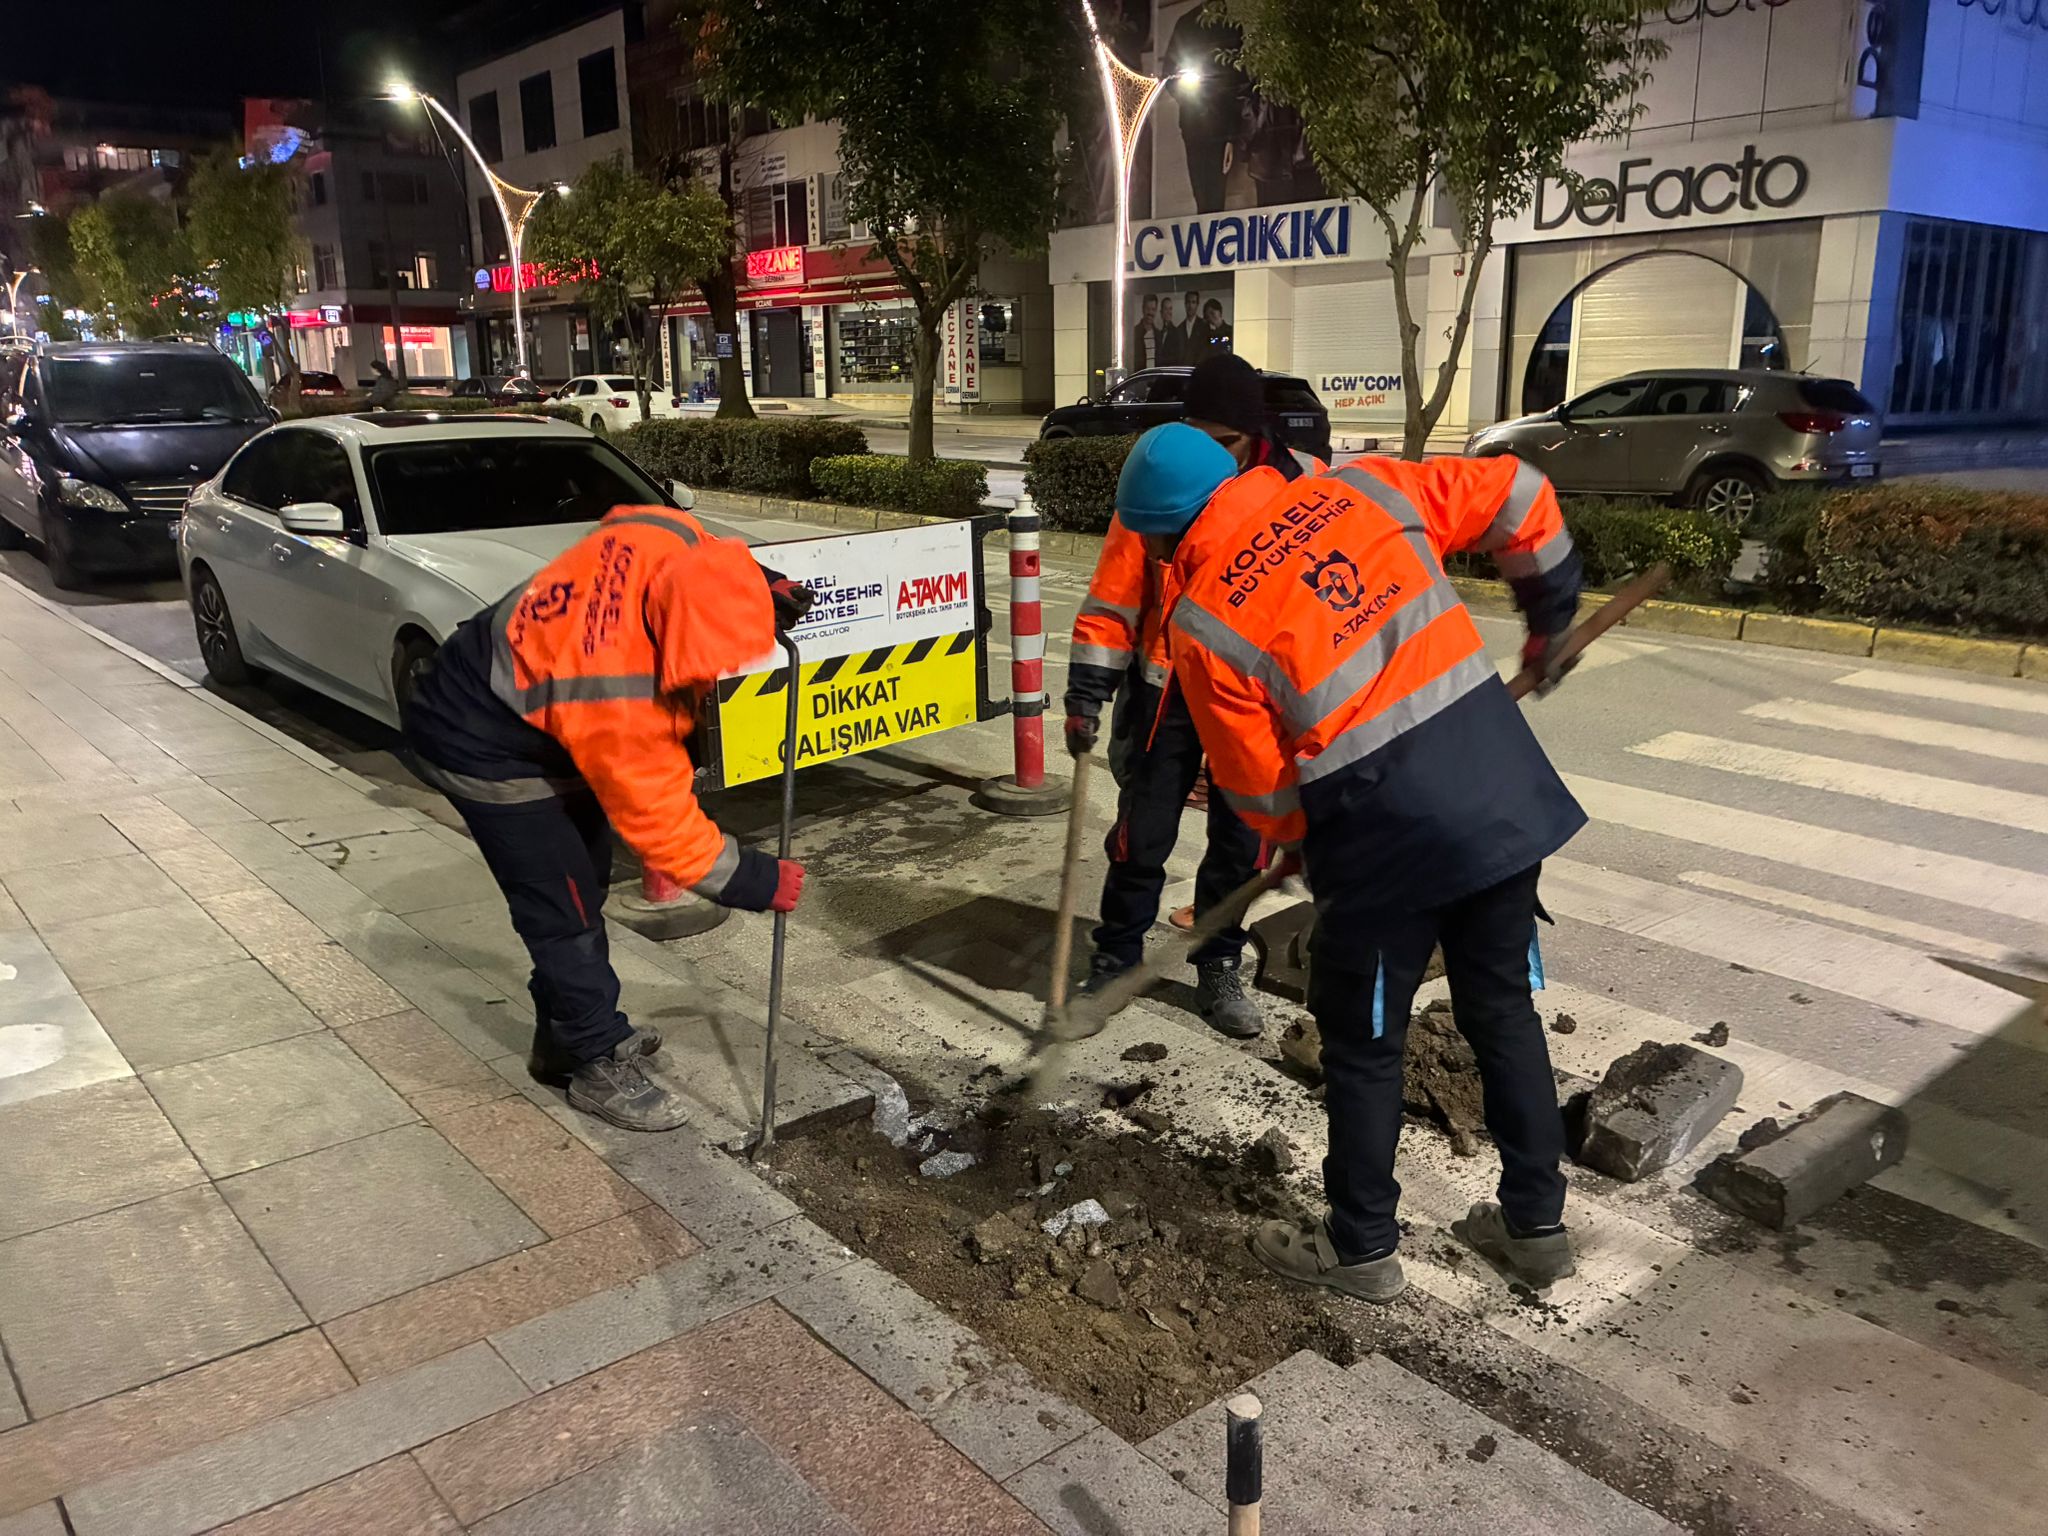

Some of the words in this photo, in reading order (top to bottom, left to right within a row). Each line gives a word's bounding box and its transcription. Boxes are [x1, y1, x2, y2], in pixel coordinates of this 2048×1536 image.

[808, 175, 817, 243] AVUKAT
[1533, 144, 1809, 231] DeFacto
[747, 248, 801, 275] ECZANE
[1127, 225, 1164, 272] C
[947, 309, 956, 384] ECZANE
[965, 303, 975, 388] ECZANE
[1334, 398, 1355, 408] HEP
[1357, 394, 1386, 408] AÇIK!
[896, 571, 968, 611] A-TAKIMI
[819, 626, 850, 638] OLUYOR
[1332, 582, 1402, 650] A-TAKIMI
[813, 675, 901, 719] DİKKAT
[894, 702, 941, 733] VAR
